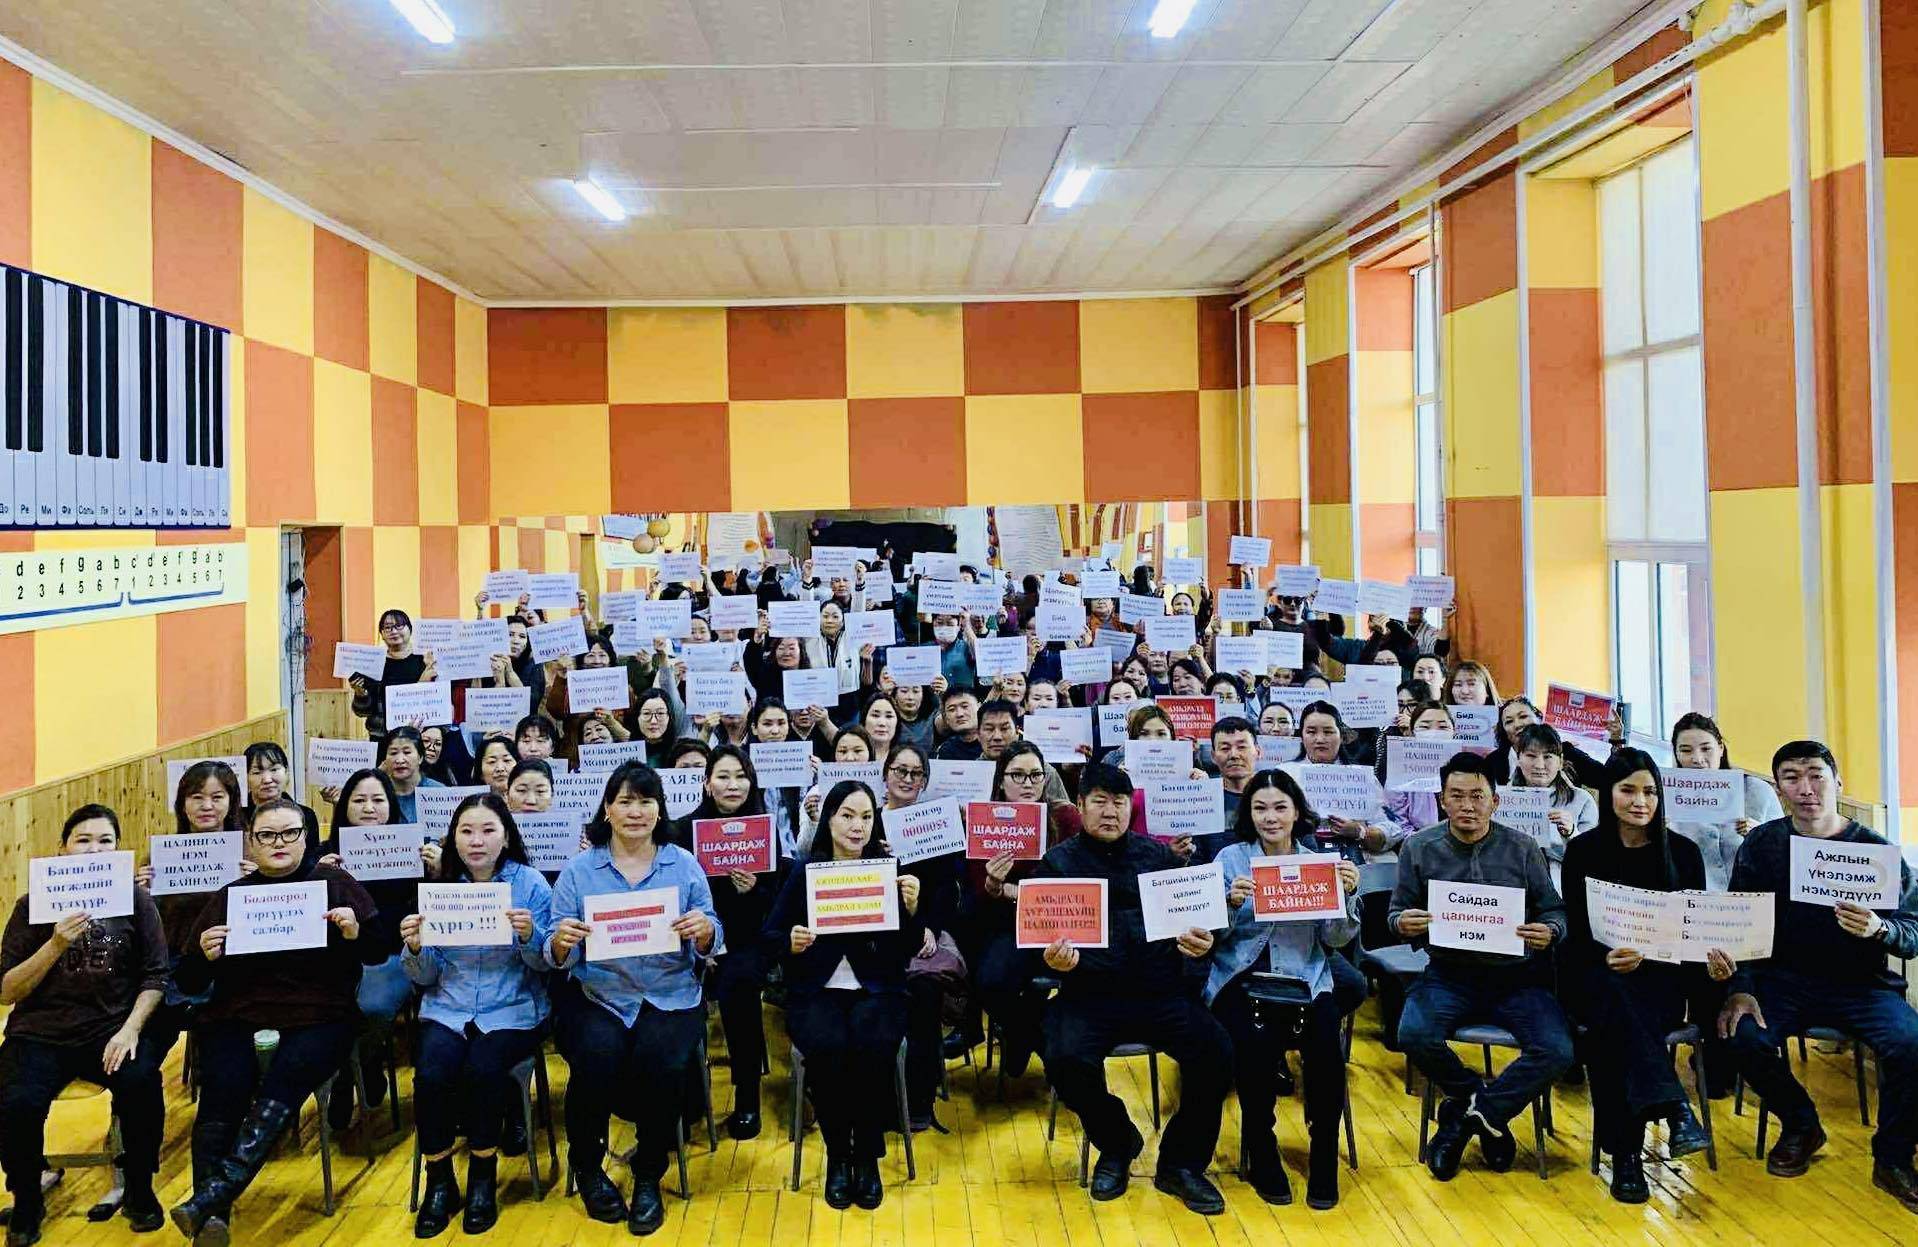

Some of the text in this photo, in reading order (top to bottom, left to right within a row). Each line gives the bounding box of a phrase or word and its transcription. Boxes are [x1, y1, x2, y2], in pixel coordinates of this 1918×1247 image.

[20, 504, 30, 514] Ре
[41, 505, 52, 514] Ми
[62, 505, 72, 514] Фа
[16, 561, 24, 576] d
[38, 563, 44, 574] e
[60, 558, 64, 573] f
[78, 556, 84, 572] g
[96, 560, 102, 570] a
[114, 555, 120, 570] b
[18, 570, 222, 600] 2 3 4 5 6 7 1 2 3 4 5 6 7
[1662, 776, 1732, 791] Шаардаж
[1674, 794, 1718, 808] байна
[972, 824, 1036, 836] ШААРДАЖ
[163, 837, 226, 848] ЦАЛИНГАА
[702, 838, 766, 852] ШААРДАЖ
[983, 836, 1026, 850] БАЙНА
[182, 851, 208, 860] НЭМ
[712, 852, 756, 866] БАЙНА
[1815, 850, 1870, 865] Ажлын
[164, 864, 225, 874] ШААРДАЖ
[1808, 868, 1876, 884] үнэлэмж
[169, 876, 220, 888] БАЙНА!!!
[1152, 877, 1189, 887] Багшийн
[1262, 882, 1330, 896] ШААРДАЖ
[244, 893, 308, 905] Боловсрол
[1448, 892, 1500, 907] Сайдаа
[1801, 884, 1882, 902] нэмэгдүүл
[1269, 894, 1325, 910] БАЙНА!!!
[1441, 912, 1504, 926] цалингаа
[1459, 932, 1486, 942] нэм
